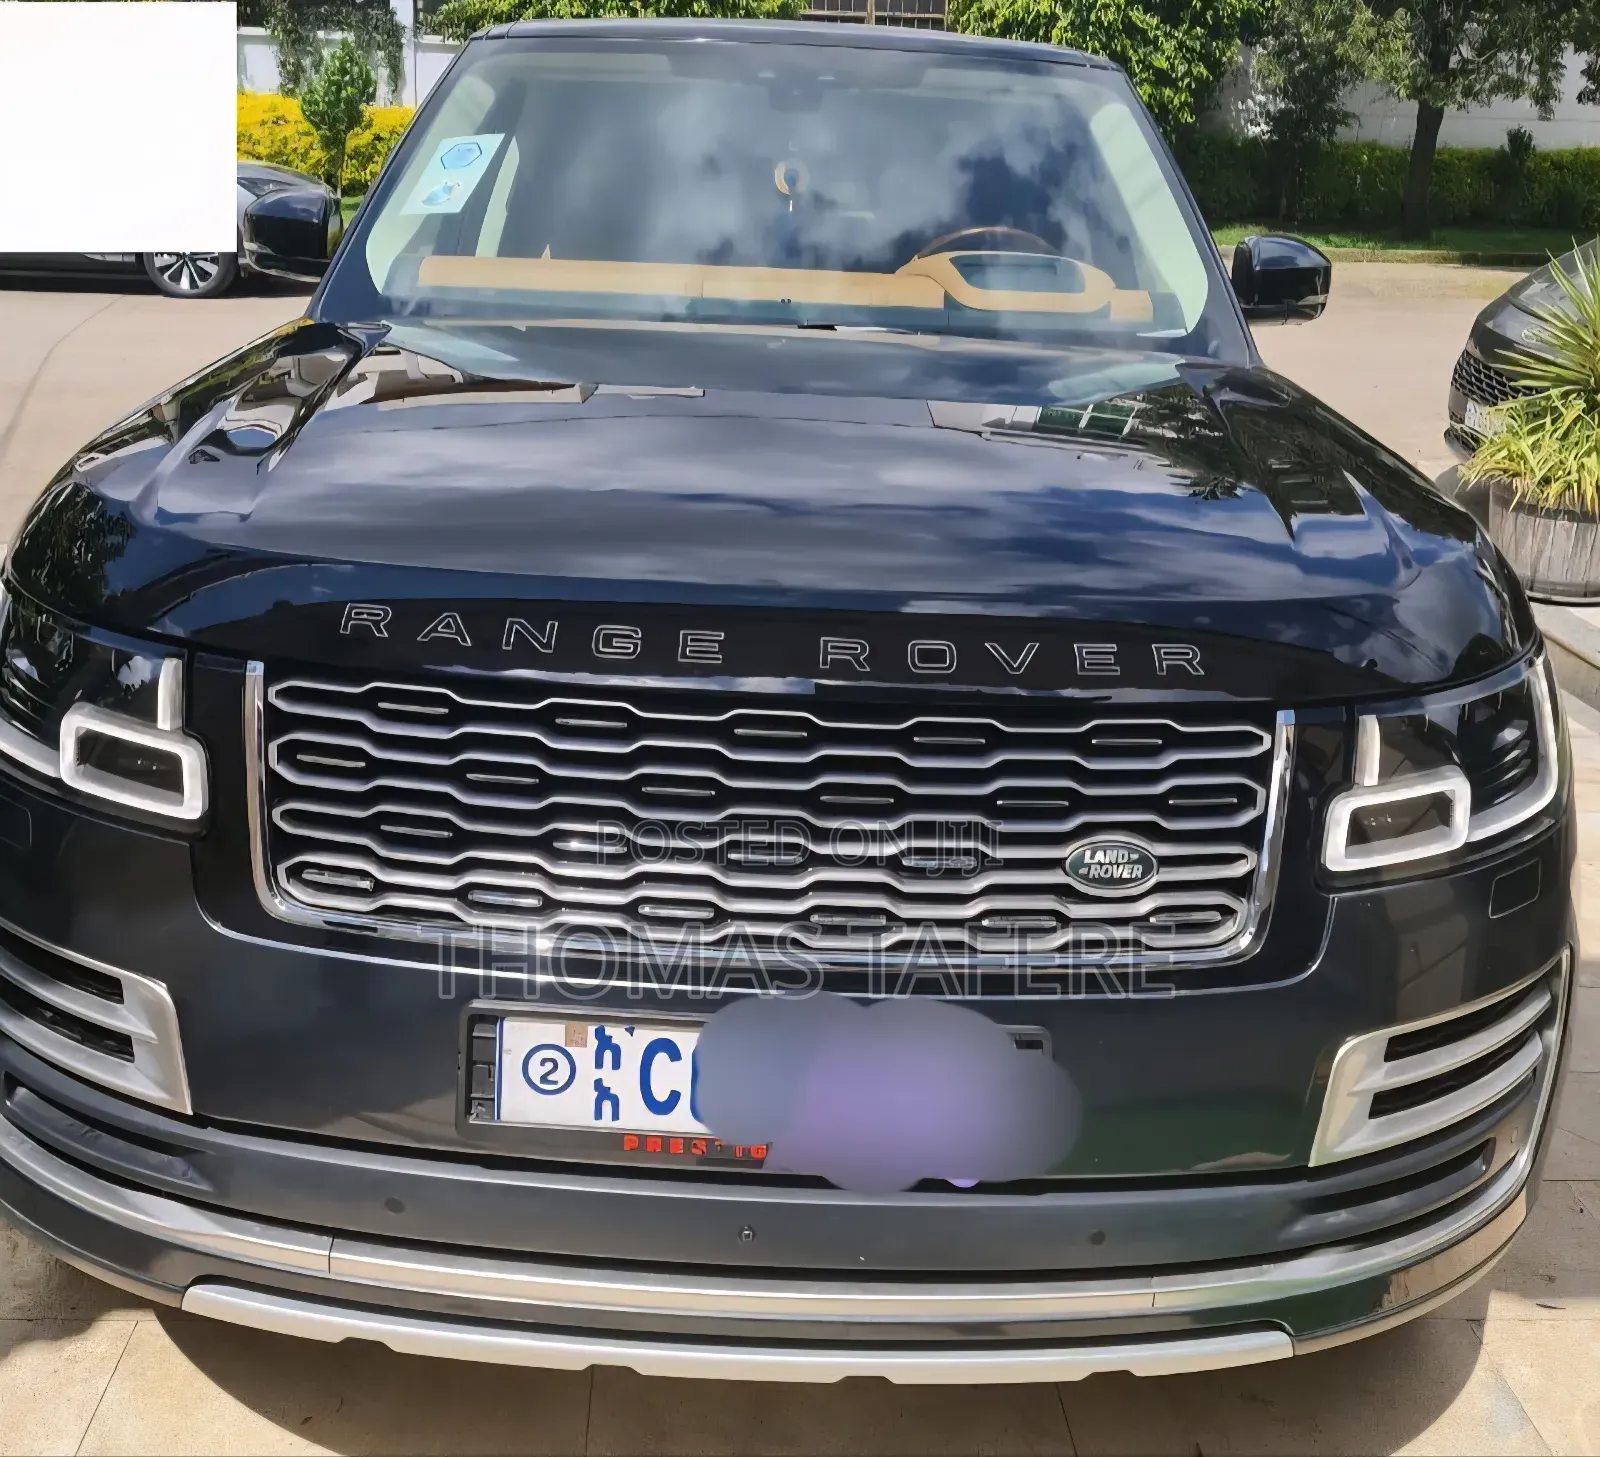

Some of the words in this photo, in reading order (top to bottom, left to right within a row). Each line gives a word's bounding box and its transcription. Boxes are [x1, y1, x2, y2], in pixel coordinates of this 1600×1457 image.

[340, 603, 725, 664] RANGE
[819, 636, 1205, 676] ROVER
[1084, 849, 1129, 864] LAND
[1088, 864, 1143, 879] ROVER
[539, 1056, 559, 1086] 2
